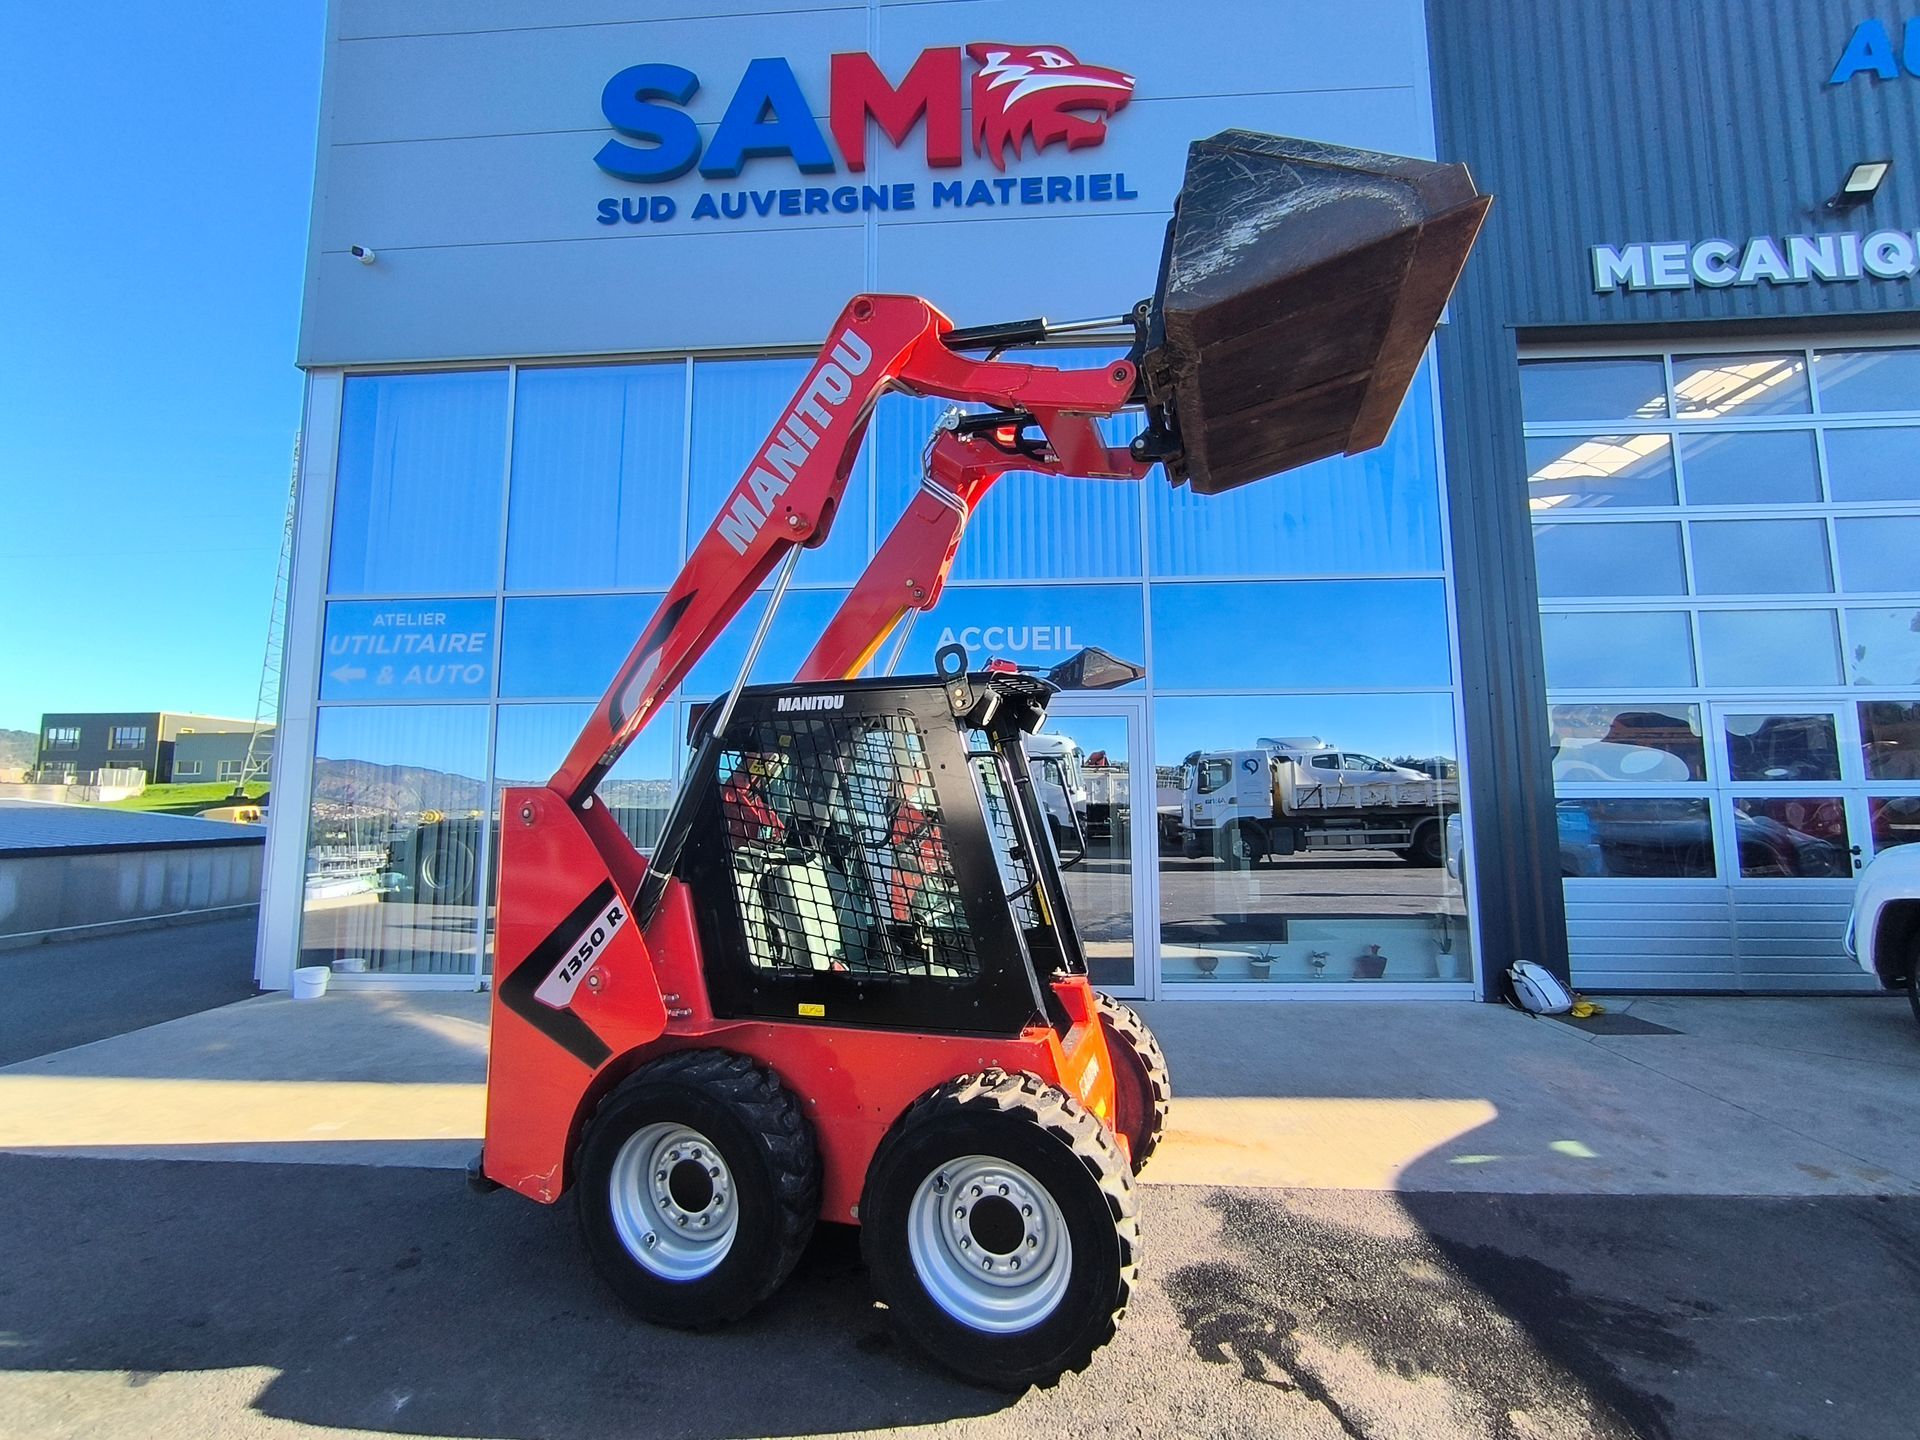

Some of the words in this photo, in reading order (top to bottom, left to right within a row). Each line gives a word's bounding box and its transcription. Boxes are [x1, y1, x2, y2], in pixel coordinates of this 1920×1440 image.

[593, 46, 963, 183] SAM
[597, 195, 677, 225] SUD
[692, 182, 915, 220] AUVERGNE
[931, 172, 1139, 208] MATERIEL
[1592, 228, 1920, 293] MECANIQ
[717, 328, 873, 556] MANITOU
[372, 612, 447, 627] ATELIER
[934, 625, 1083, 652] ACCUEIL
[329, 632, 488, 656] UTILITAIRE
[375, 665, 394, 686] &
[403, 663, 485, 686] AUTO
[777, 694, 845, 712] MANITOU
[558, 928, 606, 984] 1350
[605, 905, 625, 928] R
